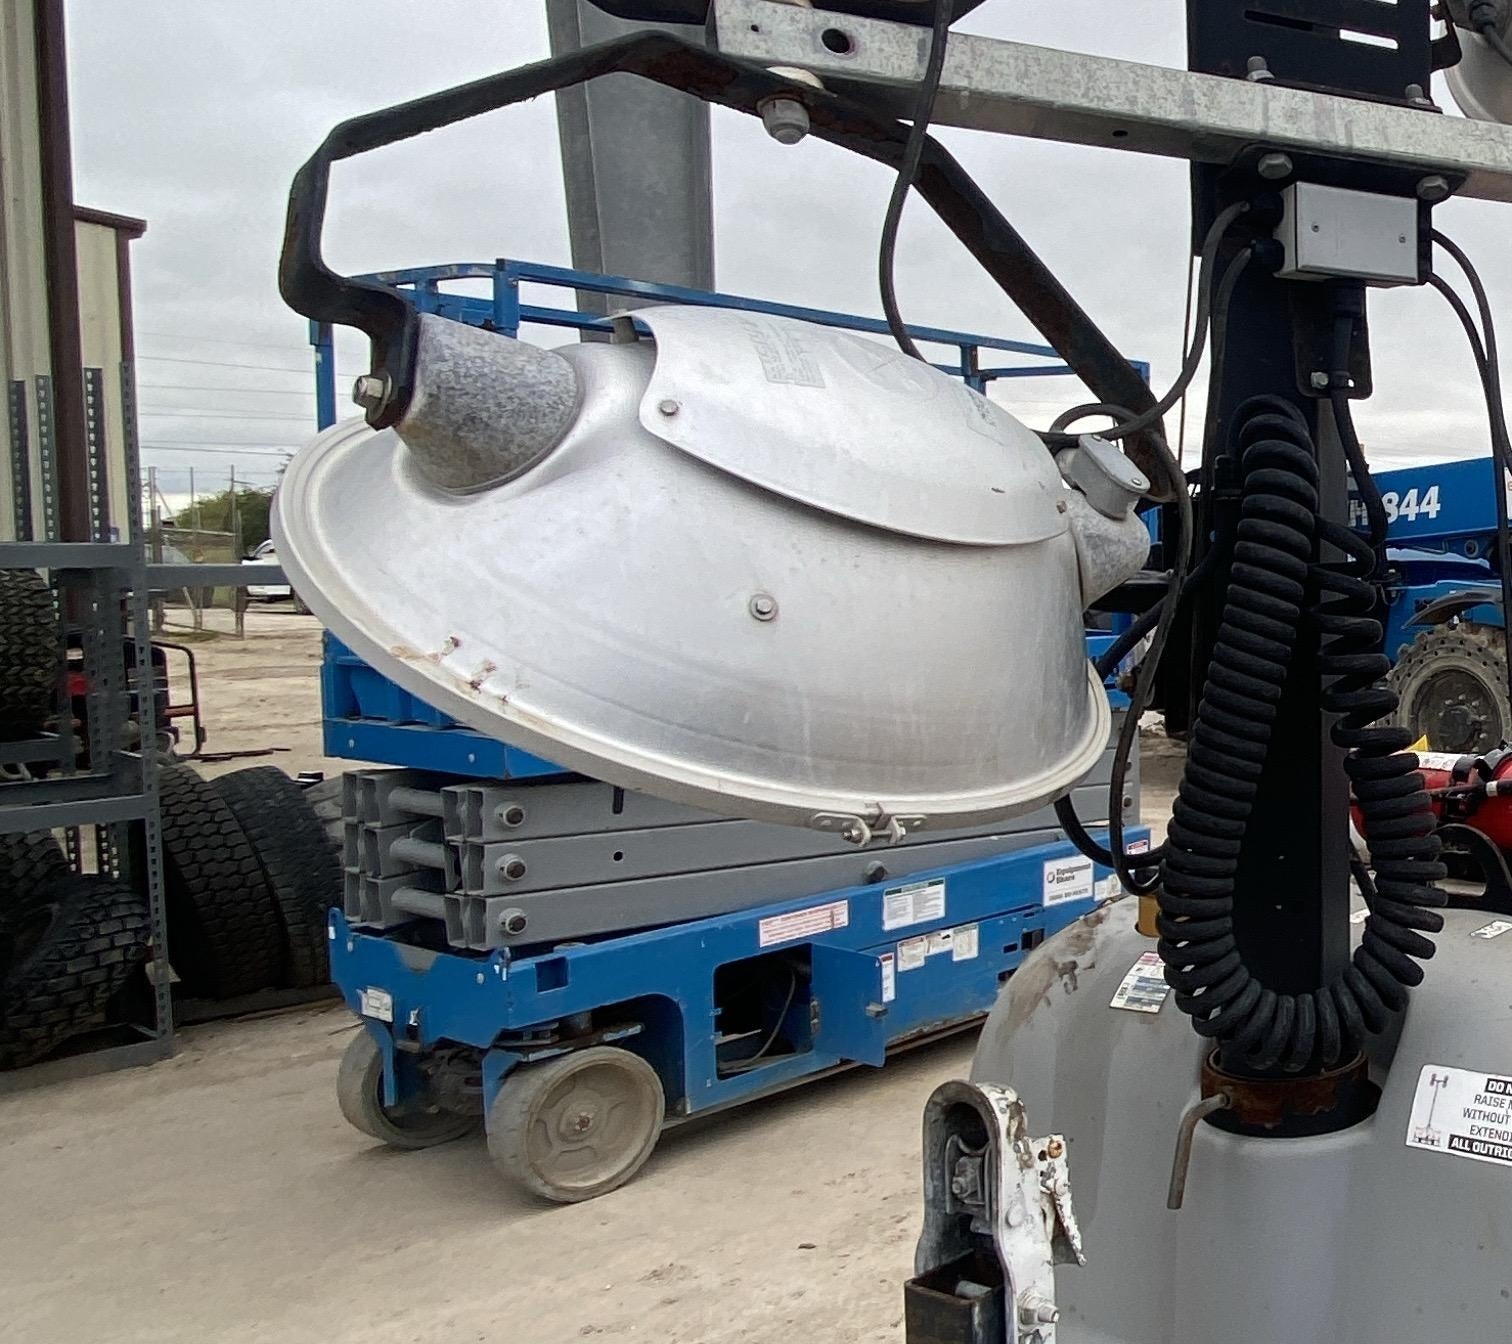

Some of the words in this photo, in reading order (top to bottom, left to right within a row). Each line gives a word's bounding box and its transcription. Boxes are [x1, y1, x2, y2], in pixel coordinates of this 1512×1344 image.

[1486, 1080, 1504, 1093] DO
[1473, 1094, 1507, 1109] RAISE
[1463, 1107, 1511, 1124] WITHOUT
[1451, 1138, 1471, 1151] ALL
